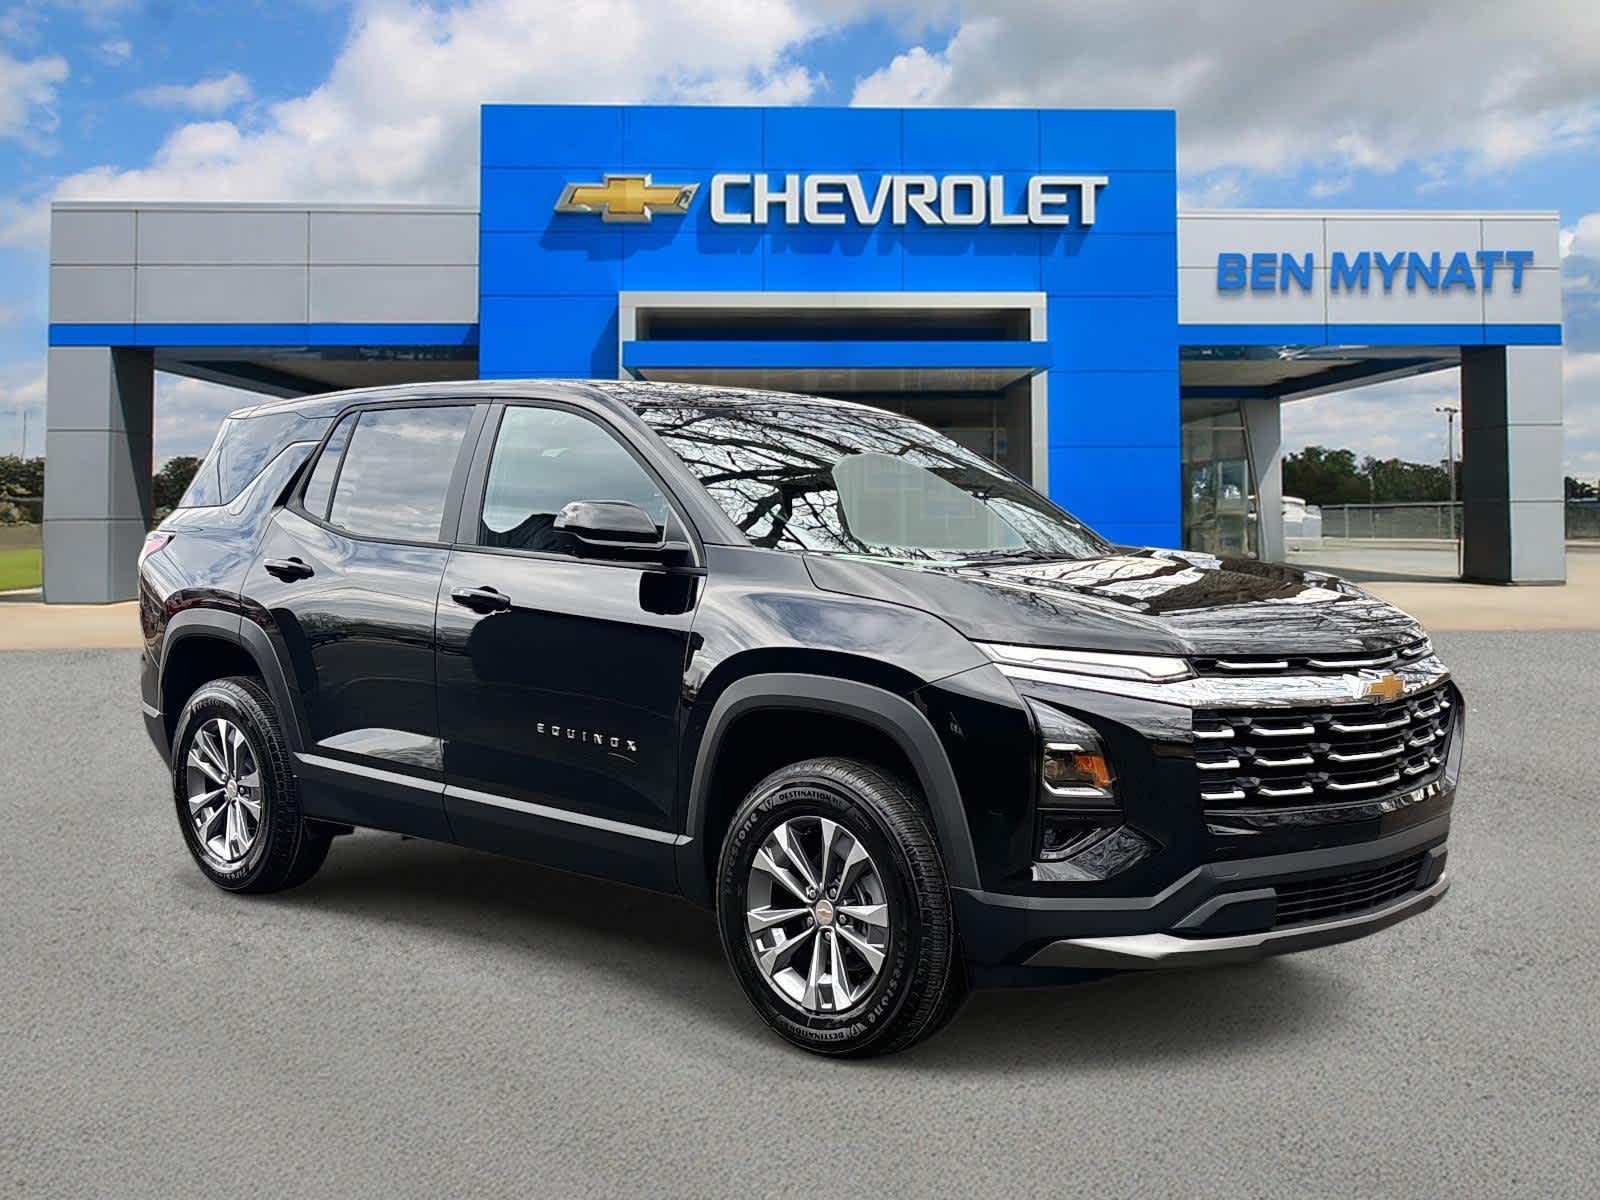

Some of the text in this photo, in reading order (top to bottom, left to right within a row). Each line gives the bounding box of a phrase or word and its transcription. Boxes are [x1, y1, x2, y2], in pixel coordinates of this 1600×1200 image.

[710, 174, 1109, 226] CHEVROLET
[1217, 250, 1535, 294] BEN MYNATT
[536, 722, 637, 752] EQUINOX
